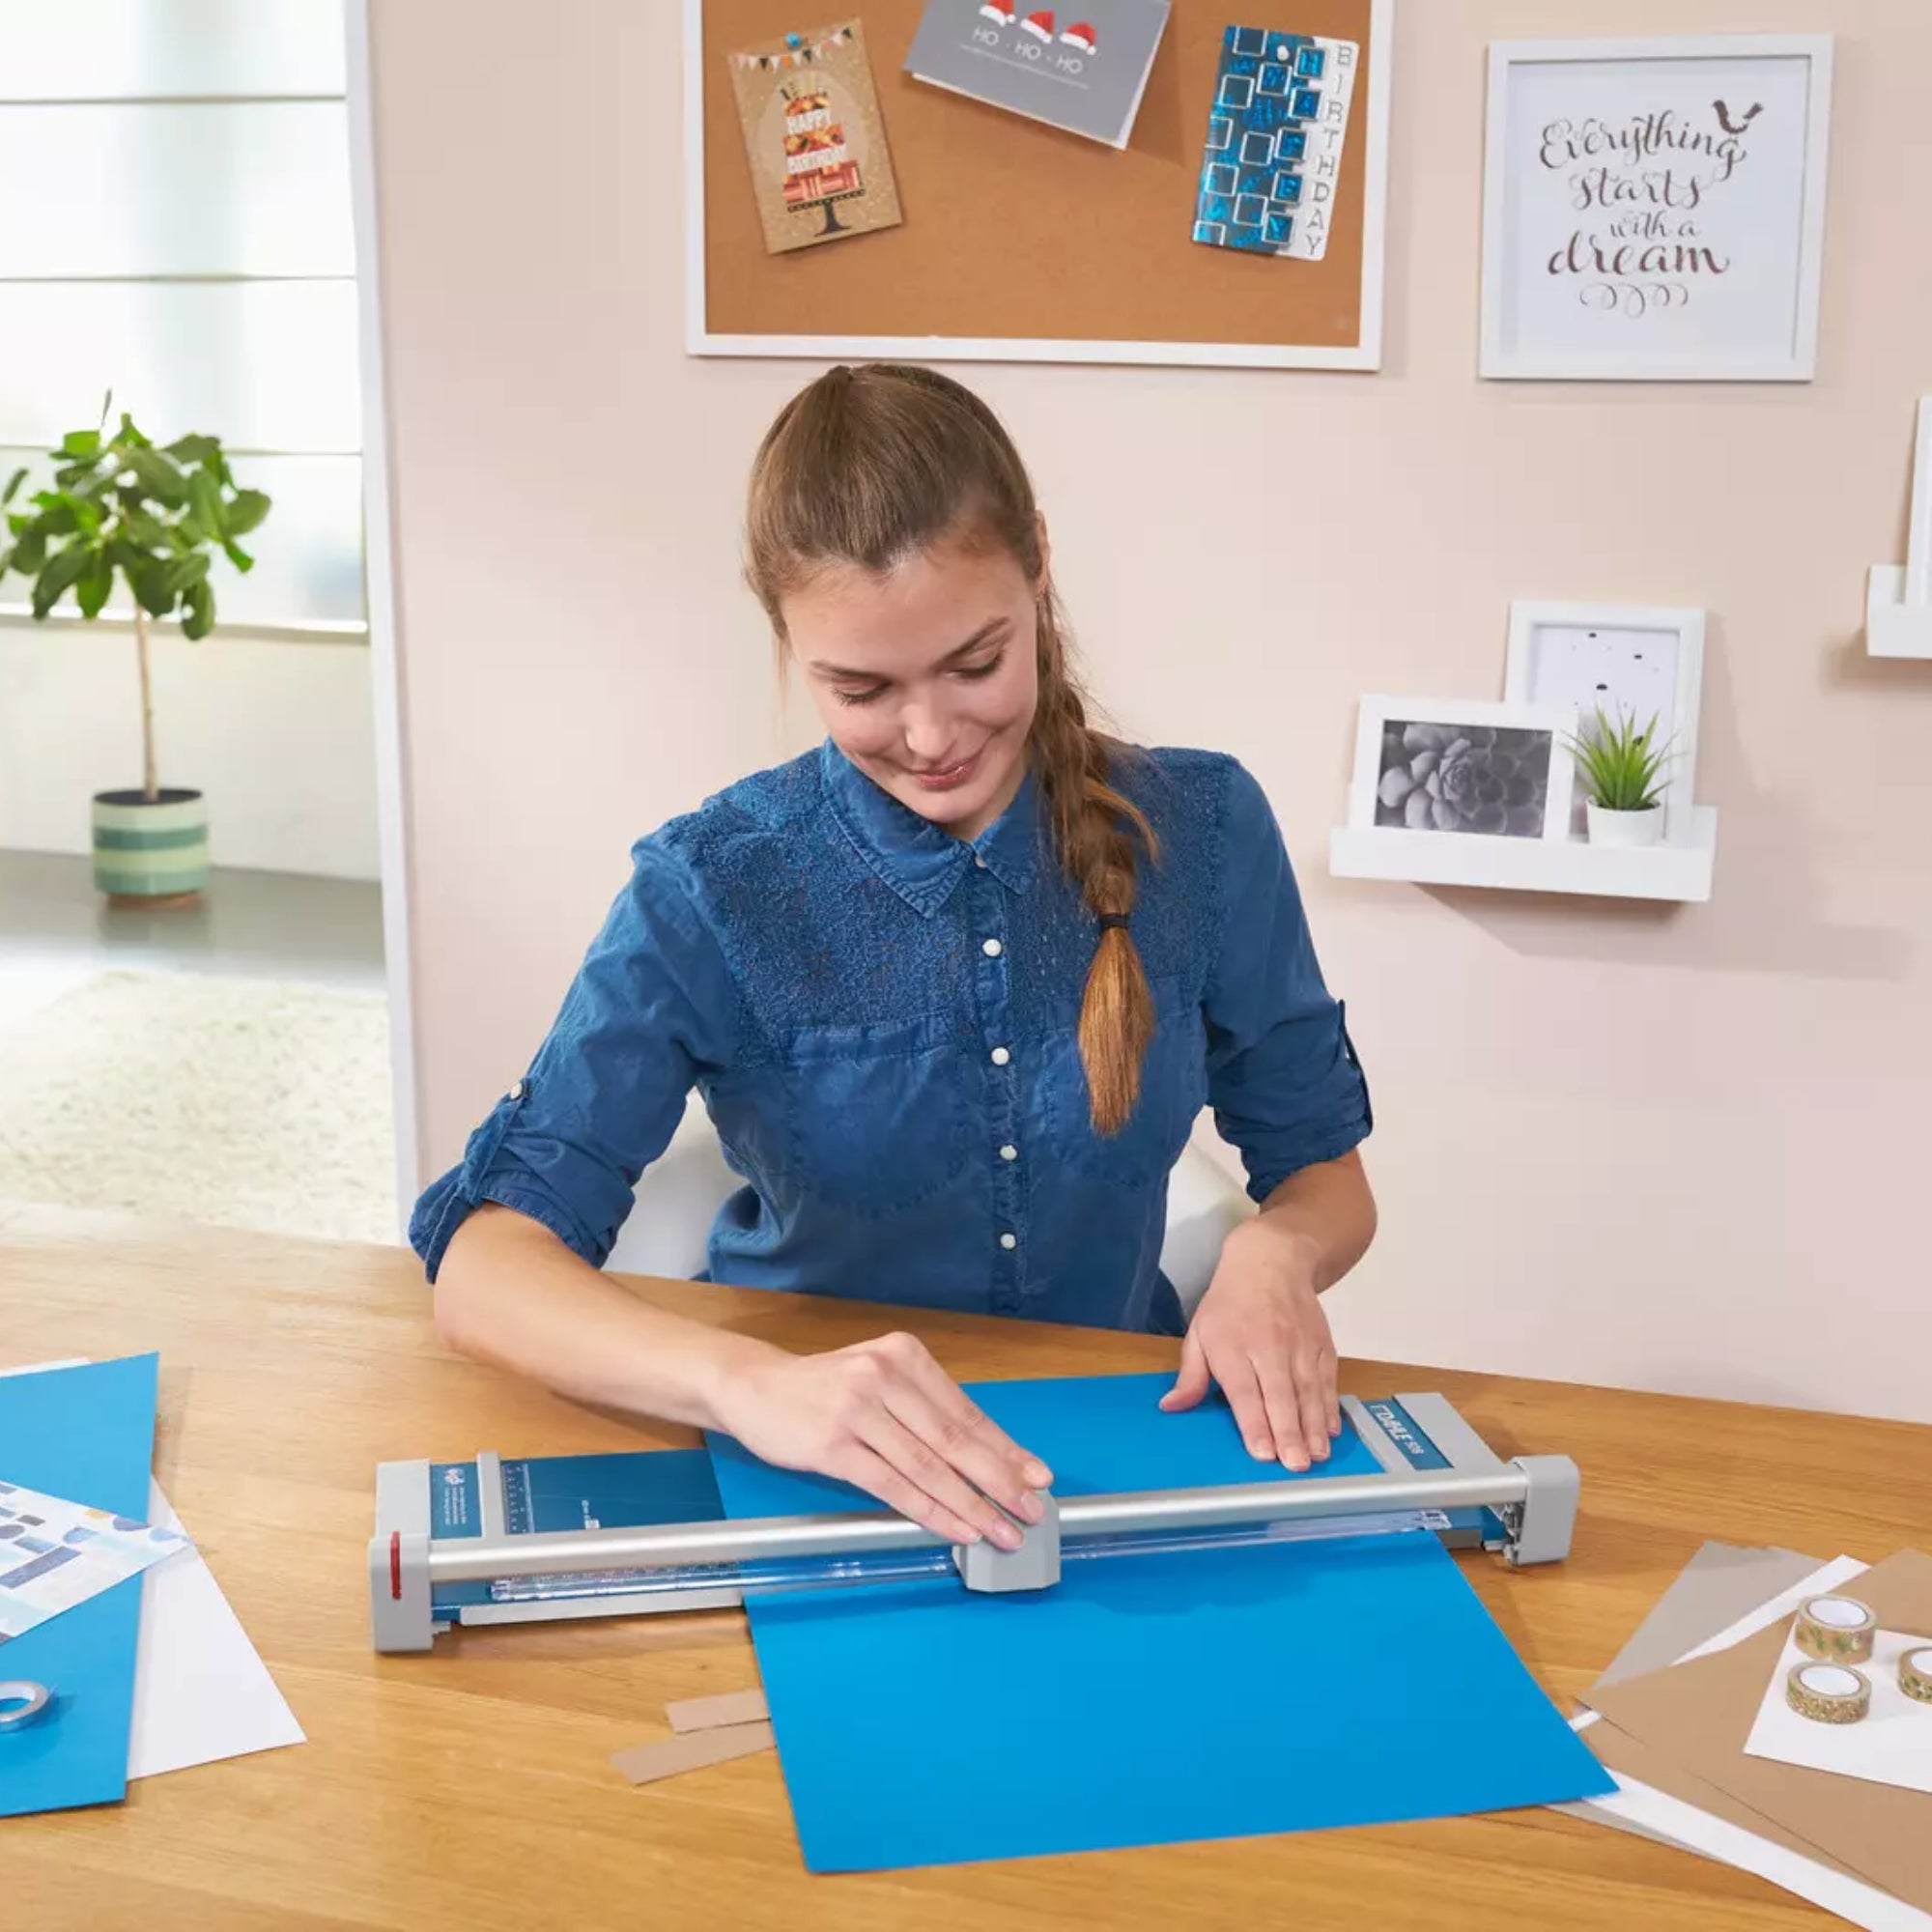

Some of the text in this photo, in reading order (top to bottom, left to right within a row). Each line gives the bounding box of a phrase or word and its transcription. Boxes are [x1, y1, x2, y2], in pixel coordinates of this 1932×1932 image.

[972, 25, 1083, 74] HO HO HO
[1306, 45, 1352, 255] BIRTHDAY
[1539, 110, 1747, 181] Everything
[1570, 167, 1703, 210] starts
[1609, 211, 1700, 240] with a
[1548, 230, 1731, 275] dream
